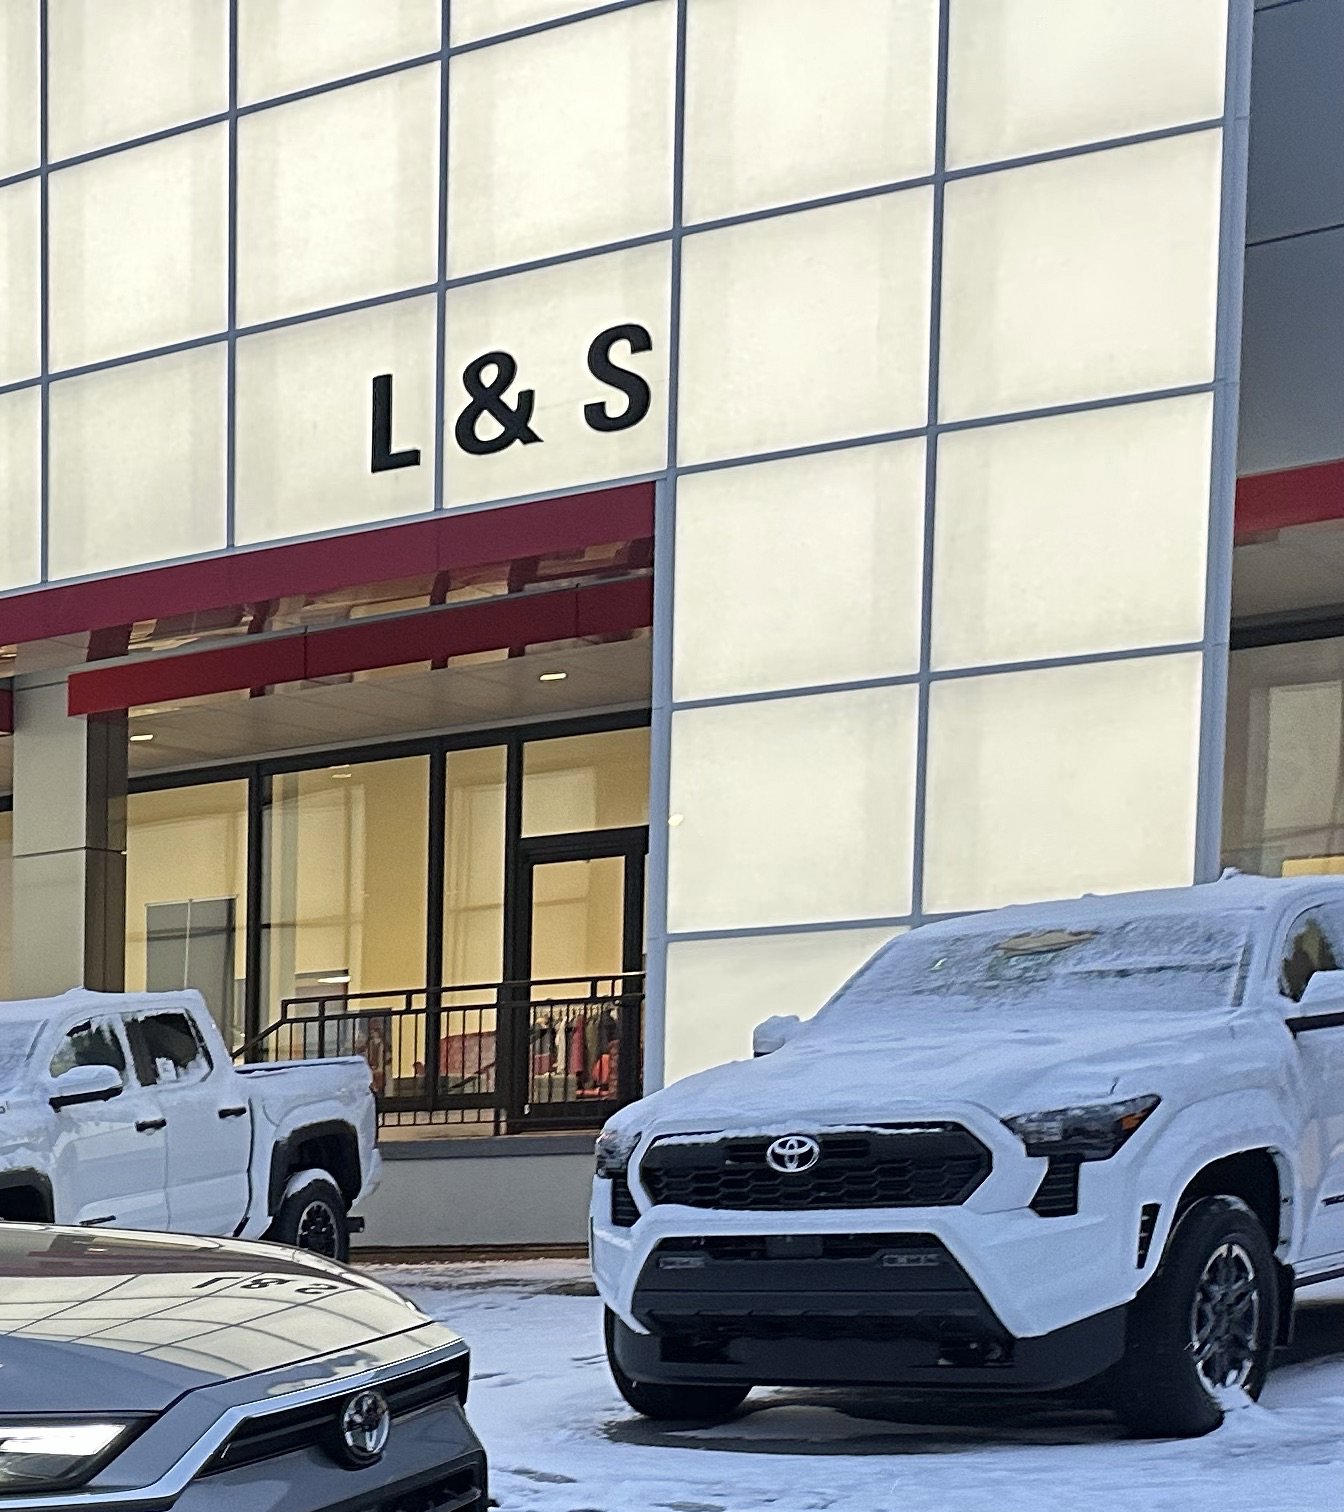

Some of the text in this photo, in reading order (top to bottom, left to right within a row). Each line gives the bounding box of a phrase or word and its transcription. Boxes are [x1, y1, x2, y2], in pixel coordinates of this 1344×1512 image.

[371, 323, 653, 473] L & S
